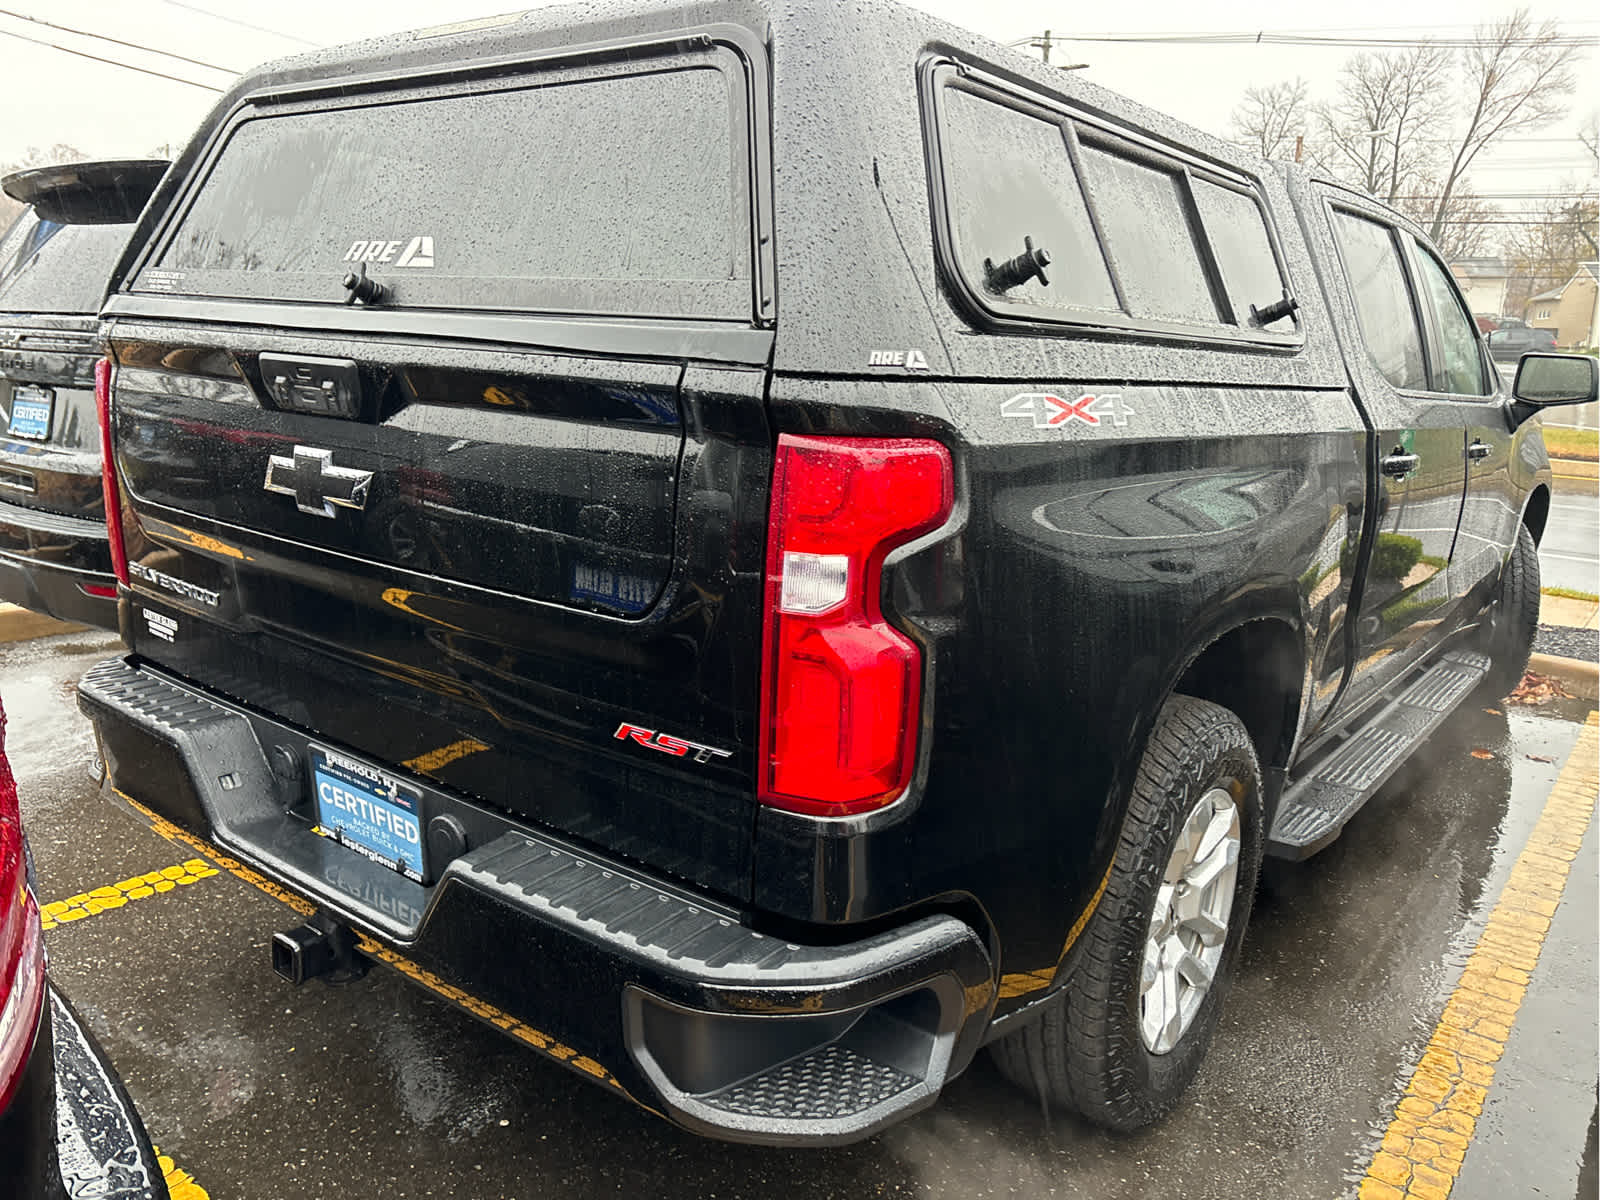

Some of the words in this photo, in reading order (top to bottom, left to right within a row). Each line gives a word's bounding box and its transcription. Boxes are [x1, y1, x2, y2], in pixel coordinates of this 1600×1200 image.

[343, 240, 402, 262] ARE
[868, 351, 904, 366] ARE
[613, 721, 734, 764] RST
[319, 782, 419, 844] CERTIFIED
